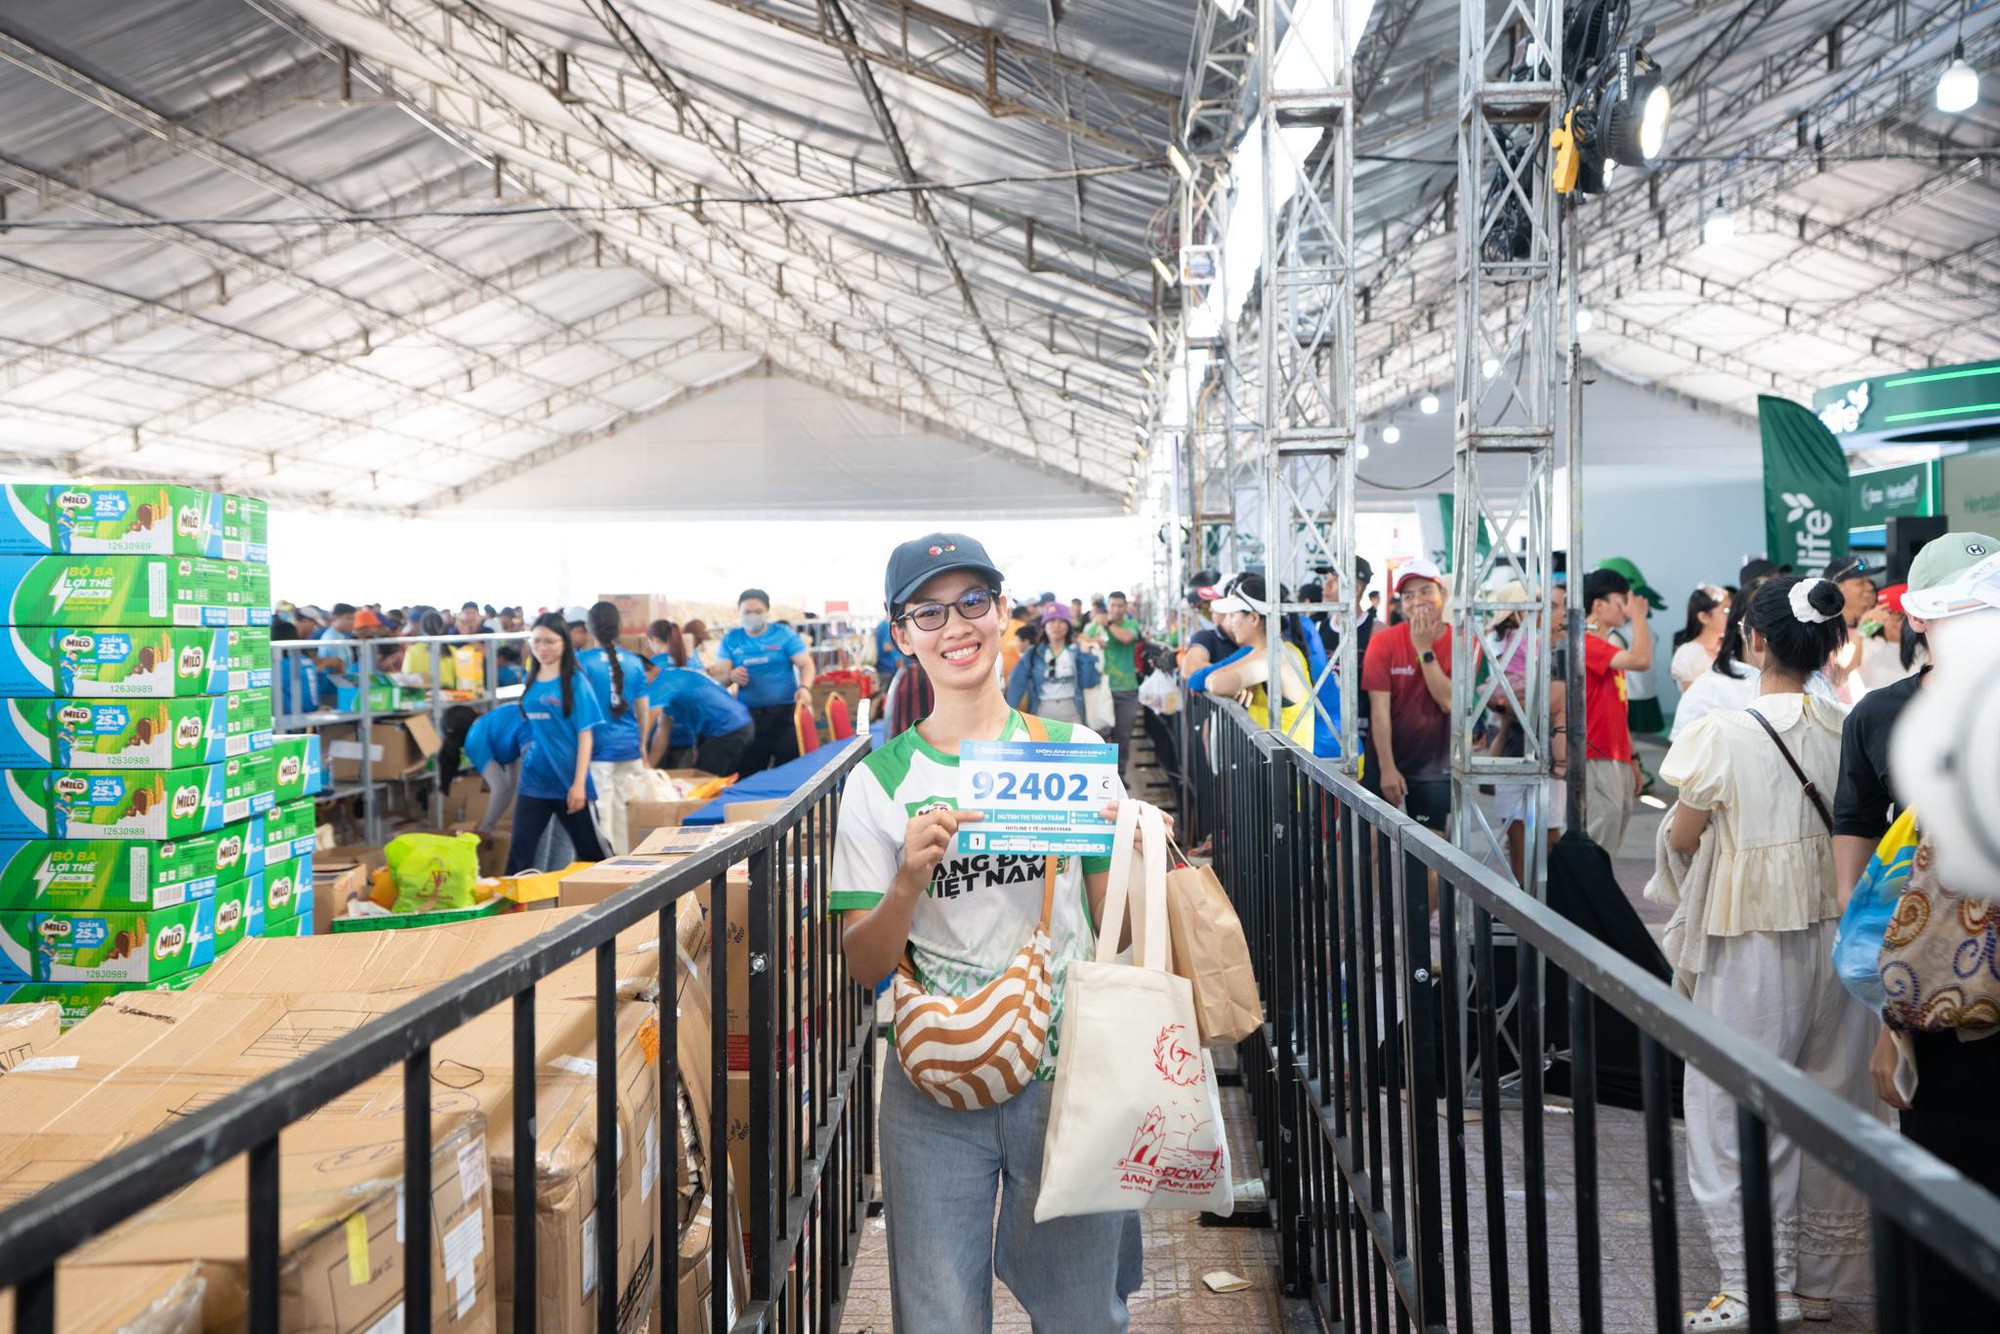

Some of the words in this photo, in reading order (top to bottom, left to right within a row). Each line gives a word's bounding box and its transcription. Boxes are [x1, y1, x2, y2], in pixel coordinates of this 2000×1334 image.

[63, 495, 87, 504] MILO
[108, 542, 151, 550] 12630989
[93, 567, 114, 577] BA
[66, 639, 90, 648] MILO
[182, 655, 200, 668] MILO
[110, 685, 153, 693] 12630989
[63, 710, 88, 719] MILO
[180, 725, 199, 739] MILO
[107, 756, 150, 765] 12630989
[281, 764, 297, 776] MILO
[60, 781, 84, 789] MILO
[972, 770, 1088, 801] 92402
[1102, 780, 1110, 789] C
[176, 795, 196, 809] MILO
[103, 827, 145, 836] 12630989
[975, 837, 980, 846] 1
[77, 851, 97, 861] BA
[219, 844, 238, 860] MILO
[925, 871, 980, 899] VIỆT
[985, 864, 1046, 888] NAM
[272, 884, 289, 899] MILO
[220, 908, 238, 923] MILO
[44, 923, 68, 931] MILO
[159, 933, 181, 949] MILO
[86, 970, 127, 979] 12630989
[69, 995, 89, 1005] BA
